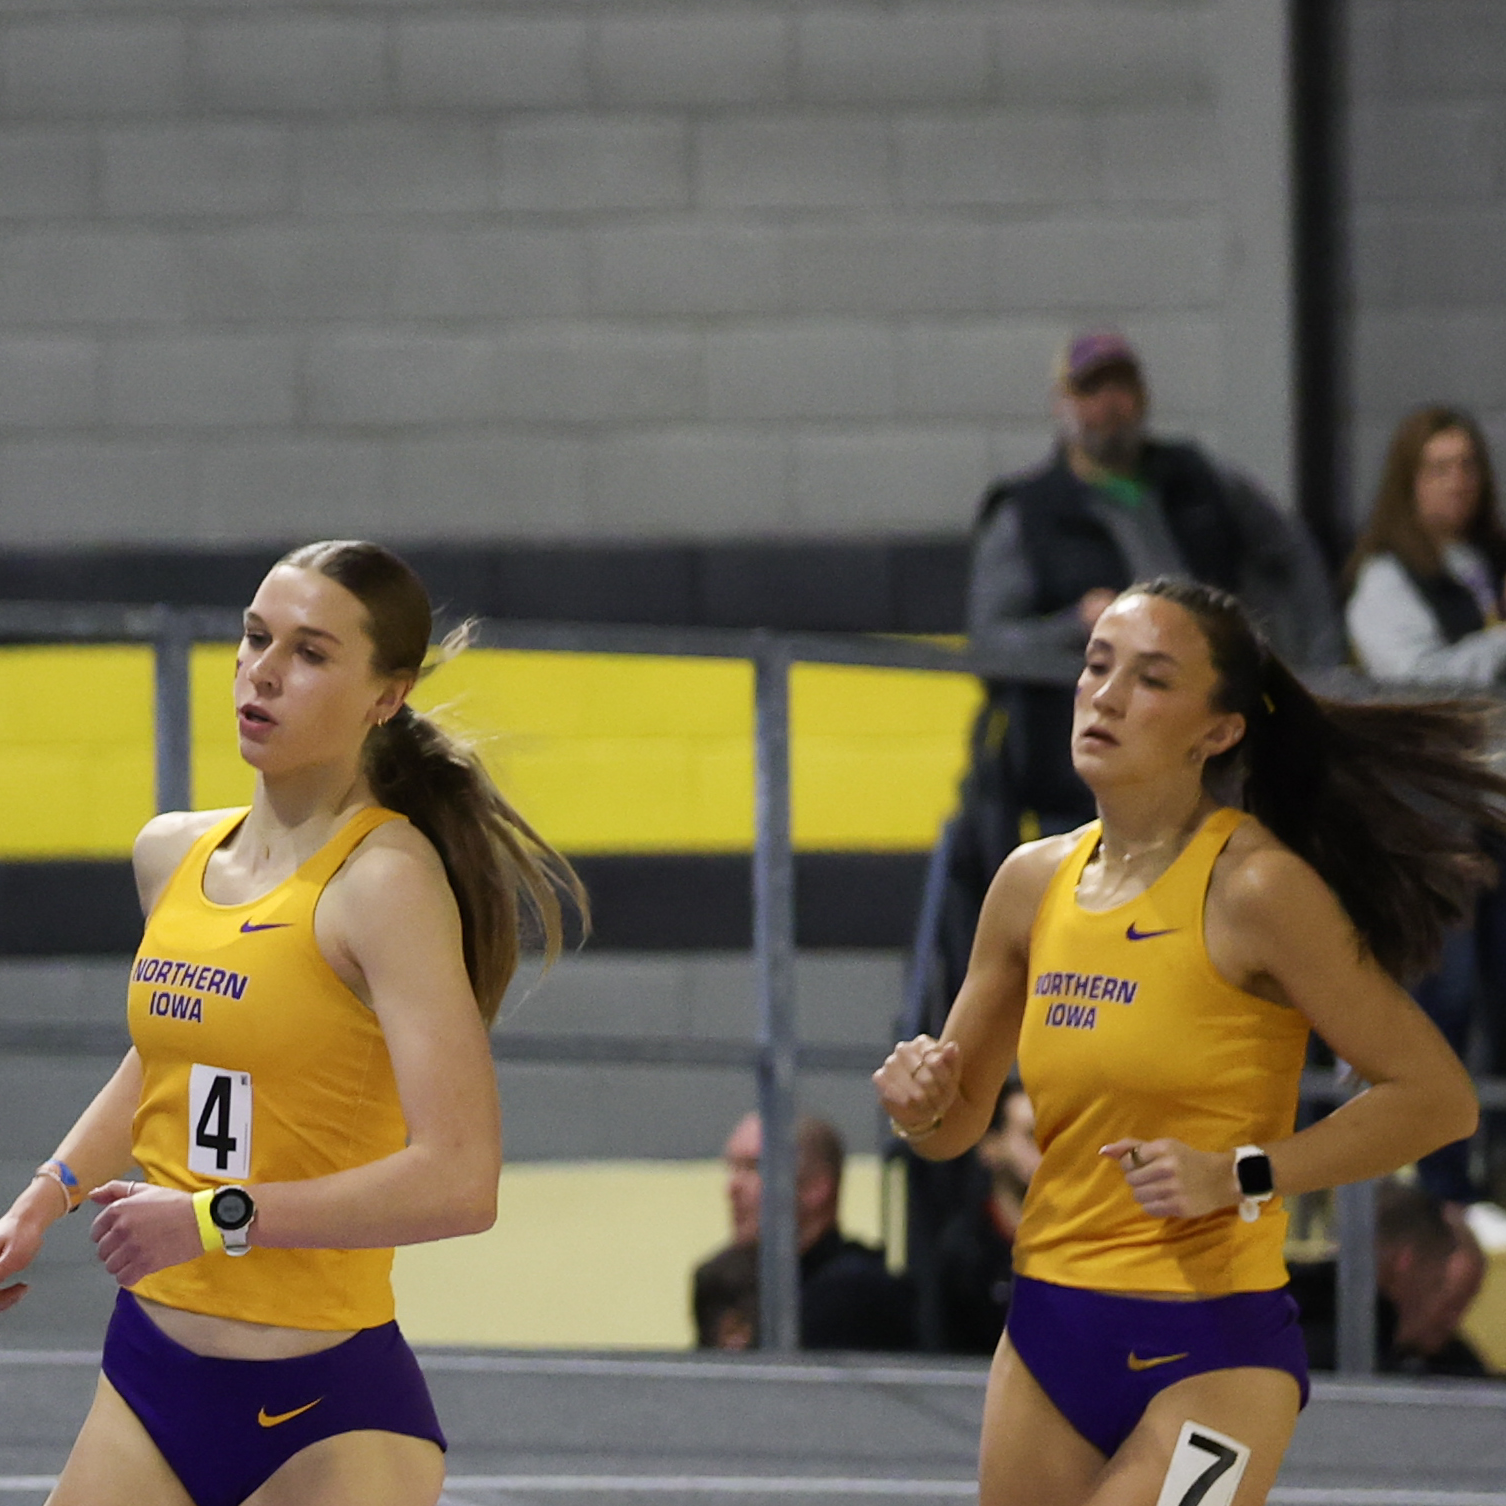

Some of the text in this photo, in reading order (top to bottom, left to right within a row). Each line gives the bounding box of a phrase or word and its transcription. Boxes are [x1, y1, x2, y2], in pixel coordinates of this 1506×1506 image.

[134, 958, 249, 1001] NORTHERN
[1035, 971, 1138, 1005] NORTHERN
[149, 992, 203, 1024] IOWA
[1044, 1003, 1098, 1031] IOWA
[195, 1074, 237, 1171] 4
